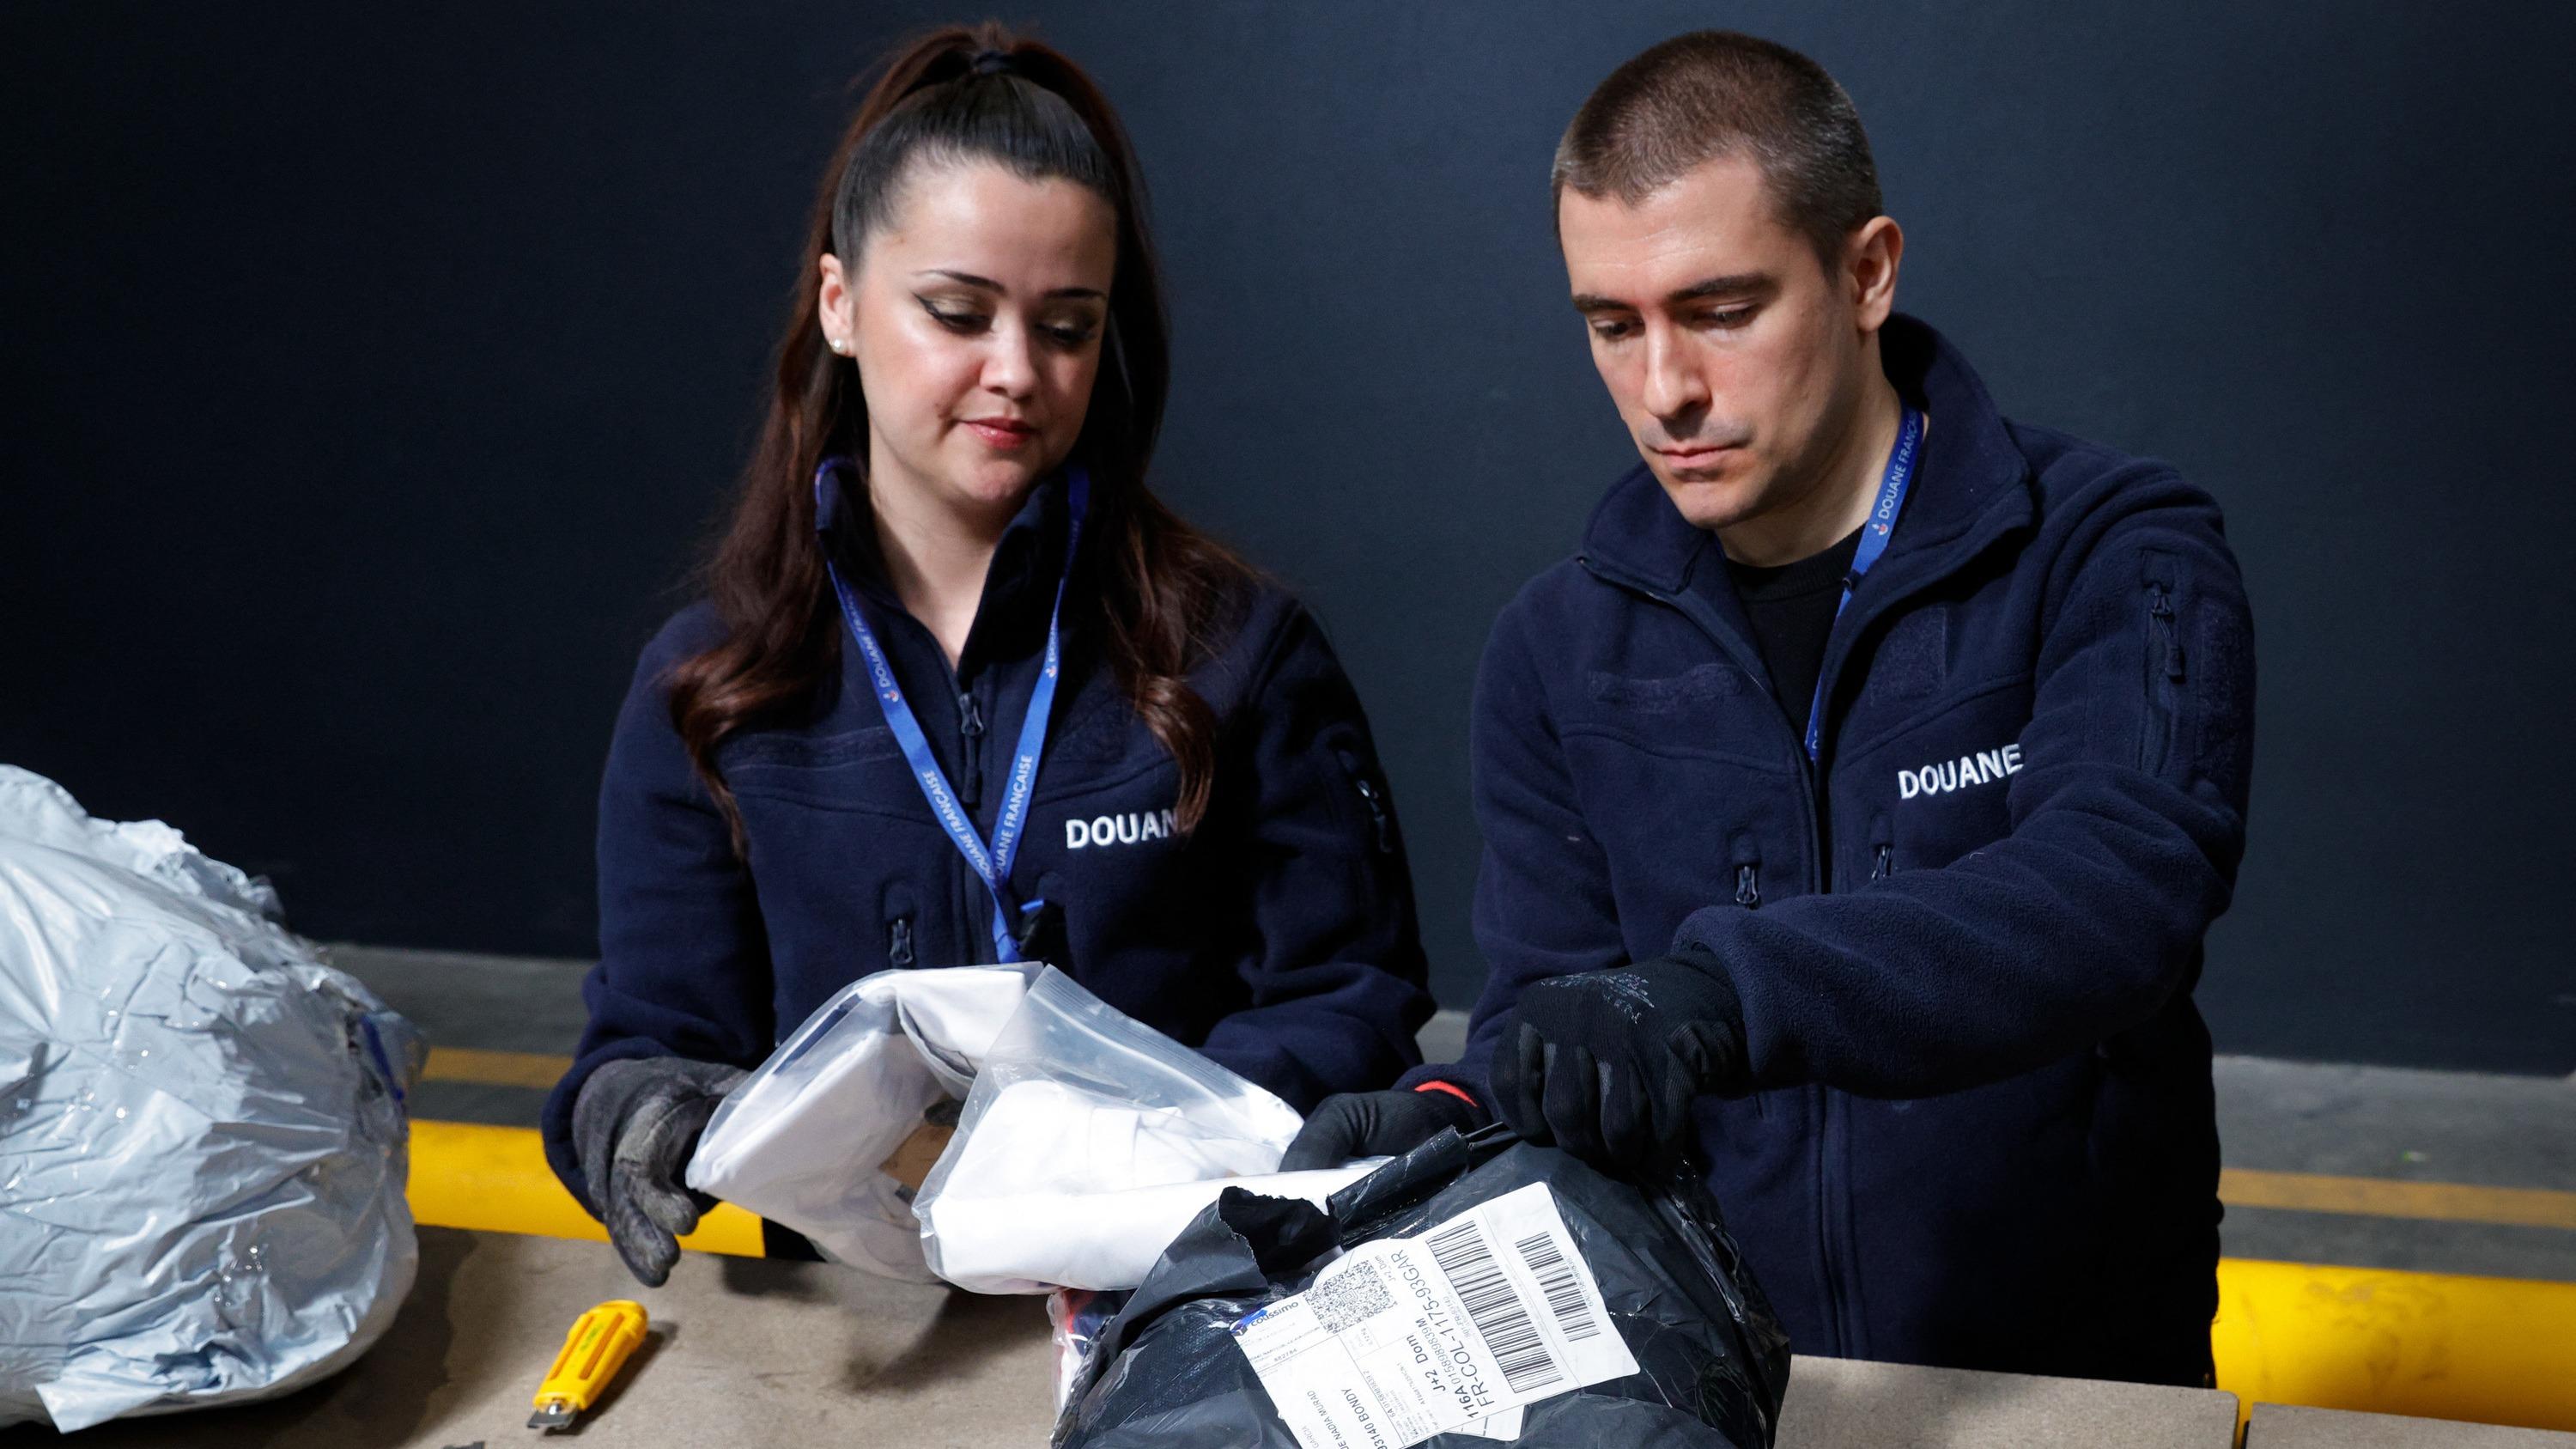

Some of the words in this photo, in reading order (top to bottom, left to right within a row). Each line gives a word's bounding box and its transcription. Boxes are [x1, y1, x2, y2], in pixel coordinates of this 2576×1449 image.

[1878, 464, 1906, 520] DOUANE
[1898, 743, 2025, 800] DOUANE
[1003, 755, 1033, 829] FRANÇAISE
[1065, 808, 1179, 849] DOUAN
[1390, 1249, 1495, 1408] FR-COL-1175-93GAR
[1406, 1334, 1429, 1364] Dom
[1425, 1369, 1447, 1391] J+2
[1307, 1390, 1327, 1417] MURAD
[1341, 1388, 1370, 1422] BONDY
[1455, 1385, 1479, 1418] 116A
[1323, 1416, 1343, 1440] NADIA
[1364, 1422, 1388, 1449] 93140
